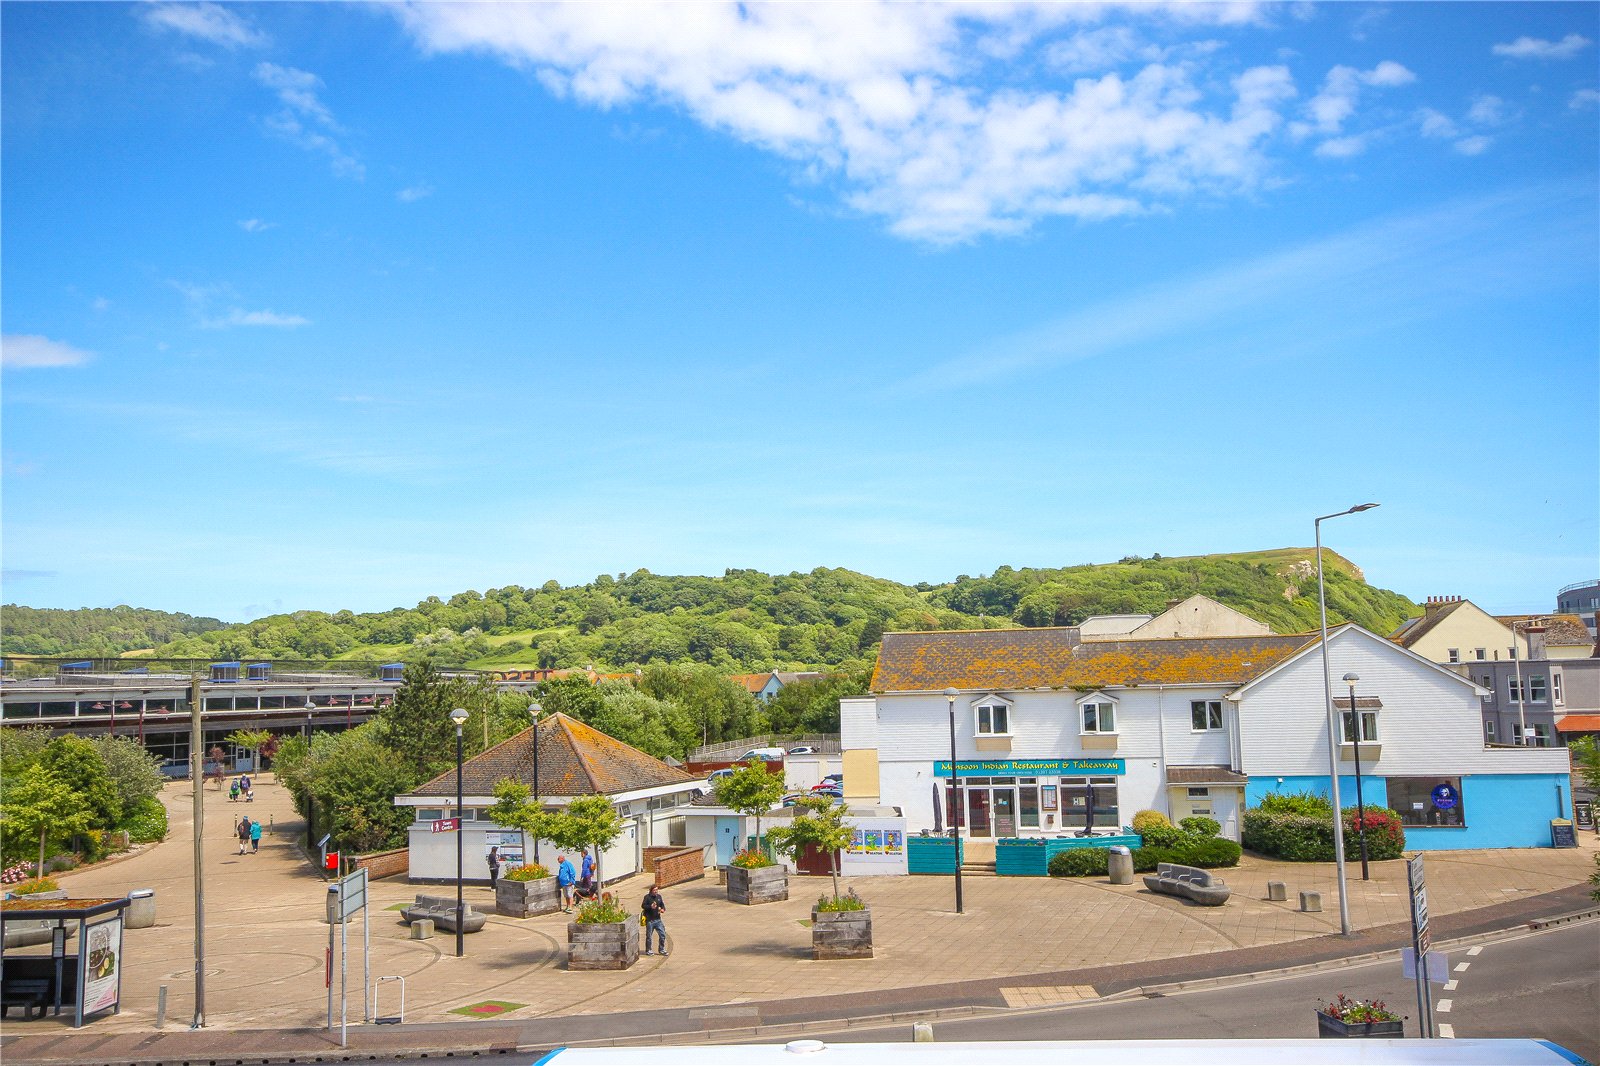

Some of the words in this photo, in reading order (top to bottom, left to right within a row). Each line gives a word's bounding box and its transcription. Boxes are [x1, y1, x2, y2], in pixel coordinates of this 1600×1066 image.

[941, 762, 979, 771] Mnsoon
[982, 762, 1009, 770] Indian
[1012, 761, 1059, 770] Restaurant
[1062, 761, 1069, 769] &
[1073, 760, 1119, 770] Takeaway
